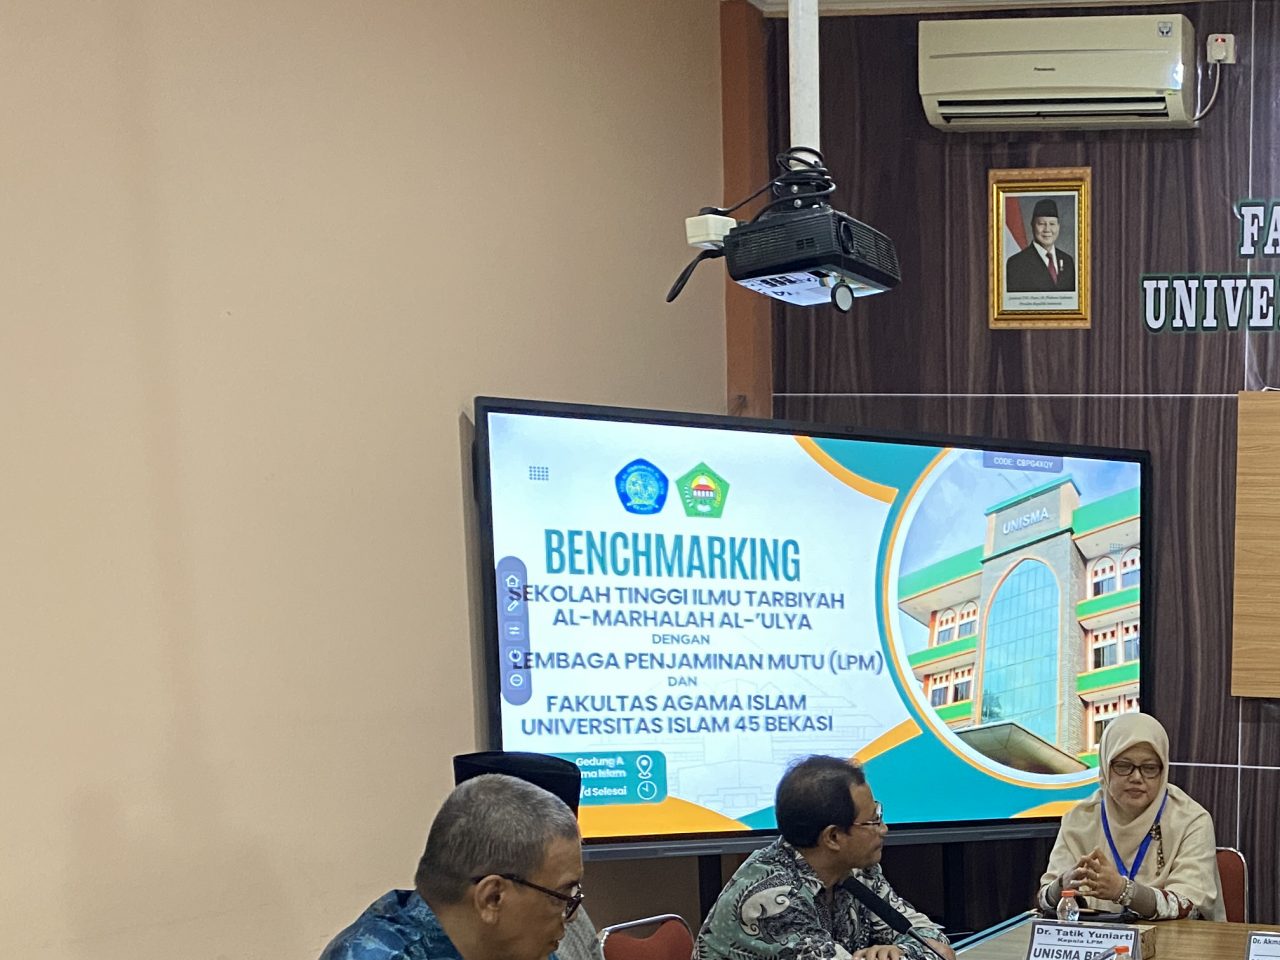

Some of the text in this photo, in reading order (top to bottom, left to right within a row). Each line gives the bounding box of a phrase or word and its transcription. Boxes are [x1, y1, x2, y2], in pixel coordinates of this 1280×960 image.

[1003, 507, 1049, 535] UNISMA
[544, 528, 800, 582] BENCHMARKING
[508, 584, 844, 610] SEKOLAH TINGGI ILMU TARBIYAH
[552, 608, 714, 629] AL-MARHALAH
[652, 633, 710, 646] DENGAN
[512, 650, 884, 675] LEMBAGA PENJAMINAN MUTU (LPM)
[667, 676, 698, 687] DAN
[546, 694, 807, 713] FAKULTAS AGAMA ISLAM
[521, 713, 834, 736] UNIVERSITAS ISLAM 45 BEKASI
[575, 756, 624, 768] Gedung A
[592, 786, 628, 797] Selesai
[1036, 927, 1133, 941] Dr. Tatik Yuniarti
[1252, 937, 1261, 945] Dr.
[1033, 947, 1081, 960] UNISMA
